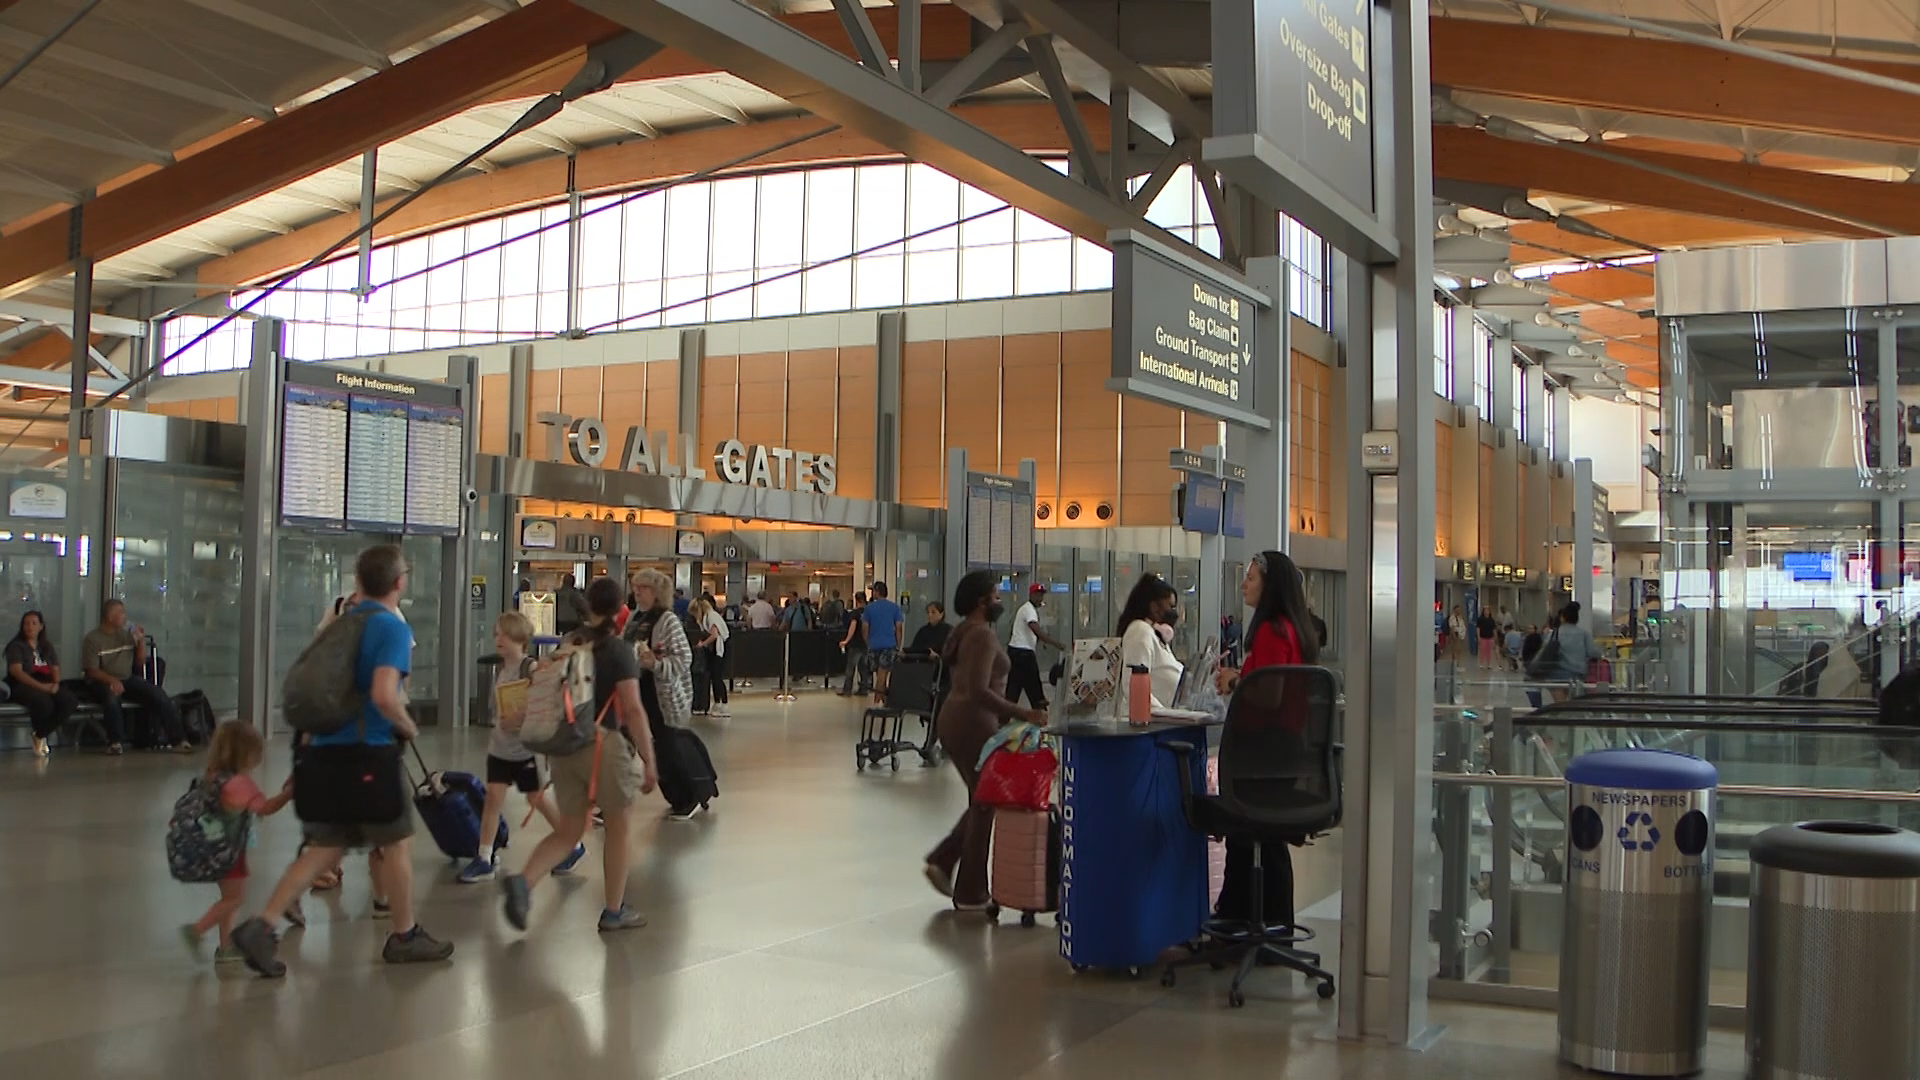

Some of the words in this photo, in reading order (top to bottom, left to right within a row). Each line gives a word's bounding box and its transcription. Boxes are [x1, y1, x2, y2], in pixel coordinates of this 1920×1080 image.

[1320, 3, 1349, 50] Gates
[1280, 17, 1328, 82] Oversize
[1331, 64, 1351, 109] Bag
[1308, 81, 1351, 141] Drop-off
[1193, 283, 1218, 310] Down
[1219, 295, 1230, 316] to:
[1188, 309, 1206, 336] Bag
[1207, 317, 1230, 342] Claim
[1156, 326, 1189, 354] Ground
[1191, 339, 1230, 369] Transport
[336, 373, 363, 388] Flight
[364, 376, 416, 395] Information
[1140, 350, 1197, 386] International
[1198, 371, 1230, 396] Arrivals
[537, 412, 607, 466] TO
[620, 426, 706, 480] ALL
[713, 439, 837, 494] GATES
[591, 537, 600, 550] 9
[723, 546, 736, 559] 10
[1592, 791, 1687, 808] NEWSPAPERS
[1061, 747, 1075, 957] INFORMATION
